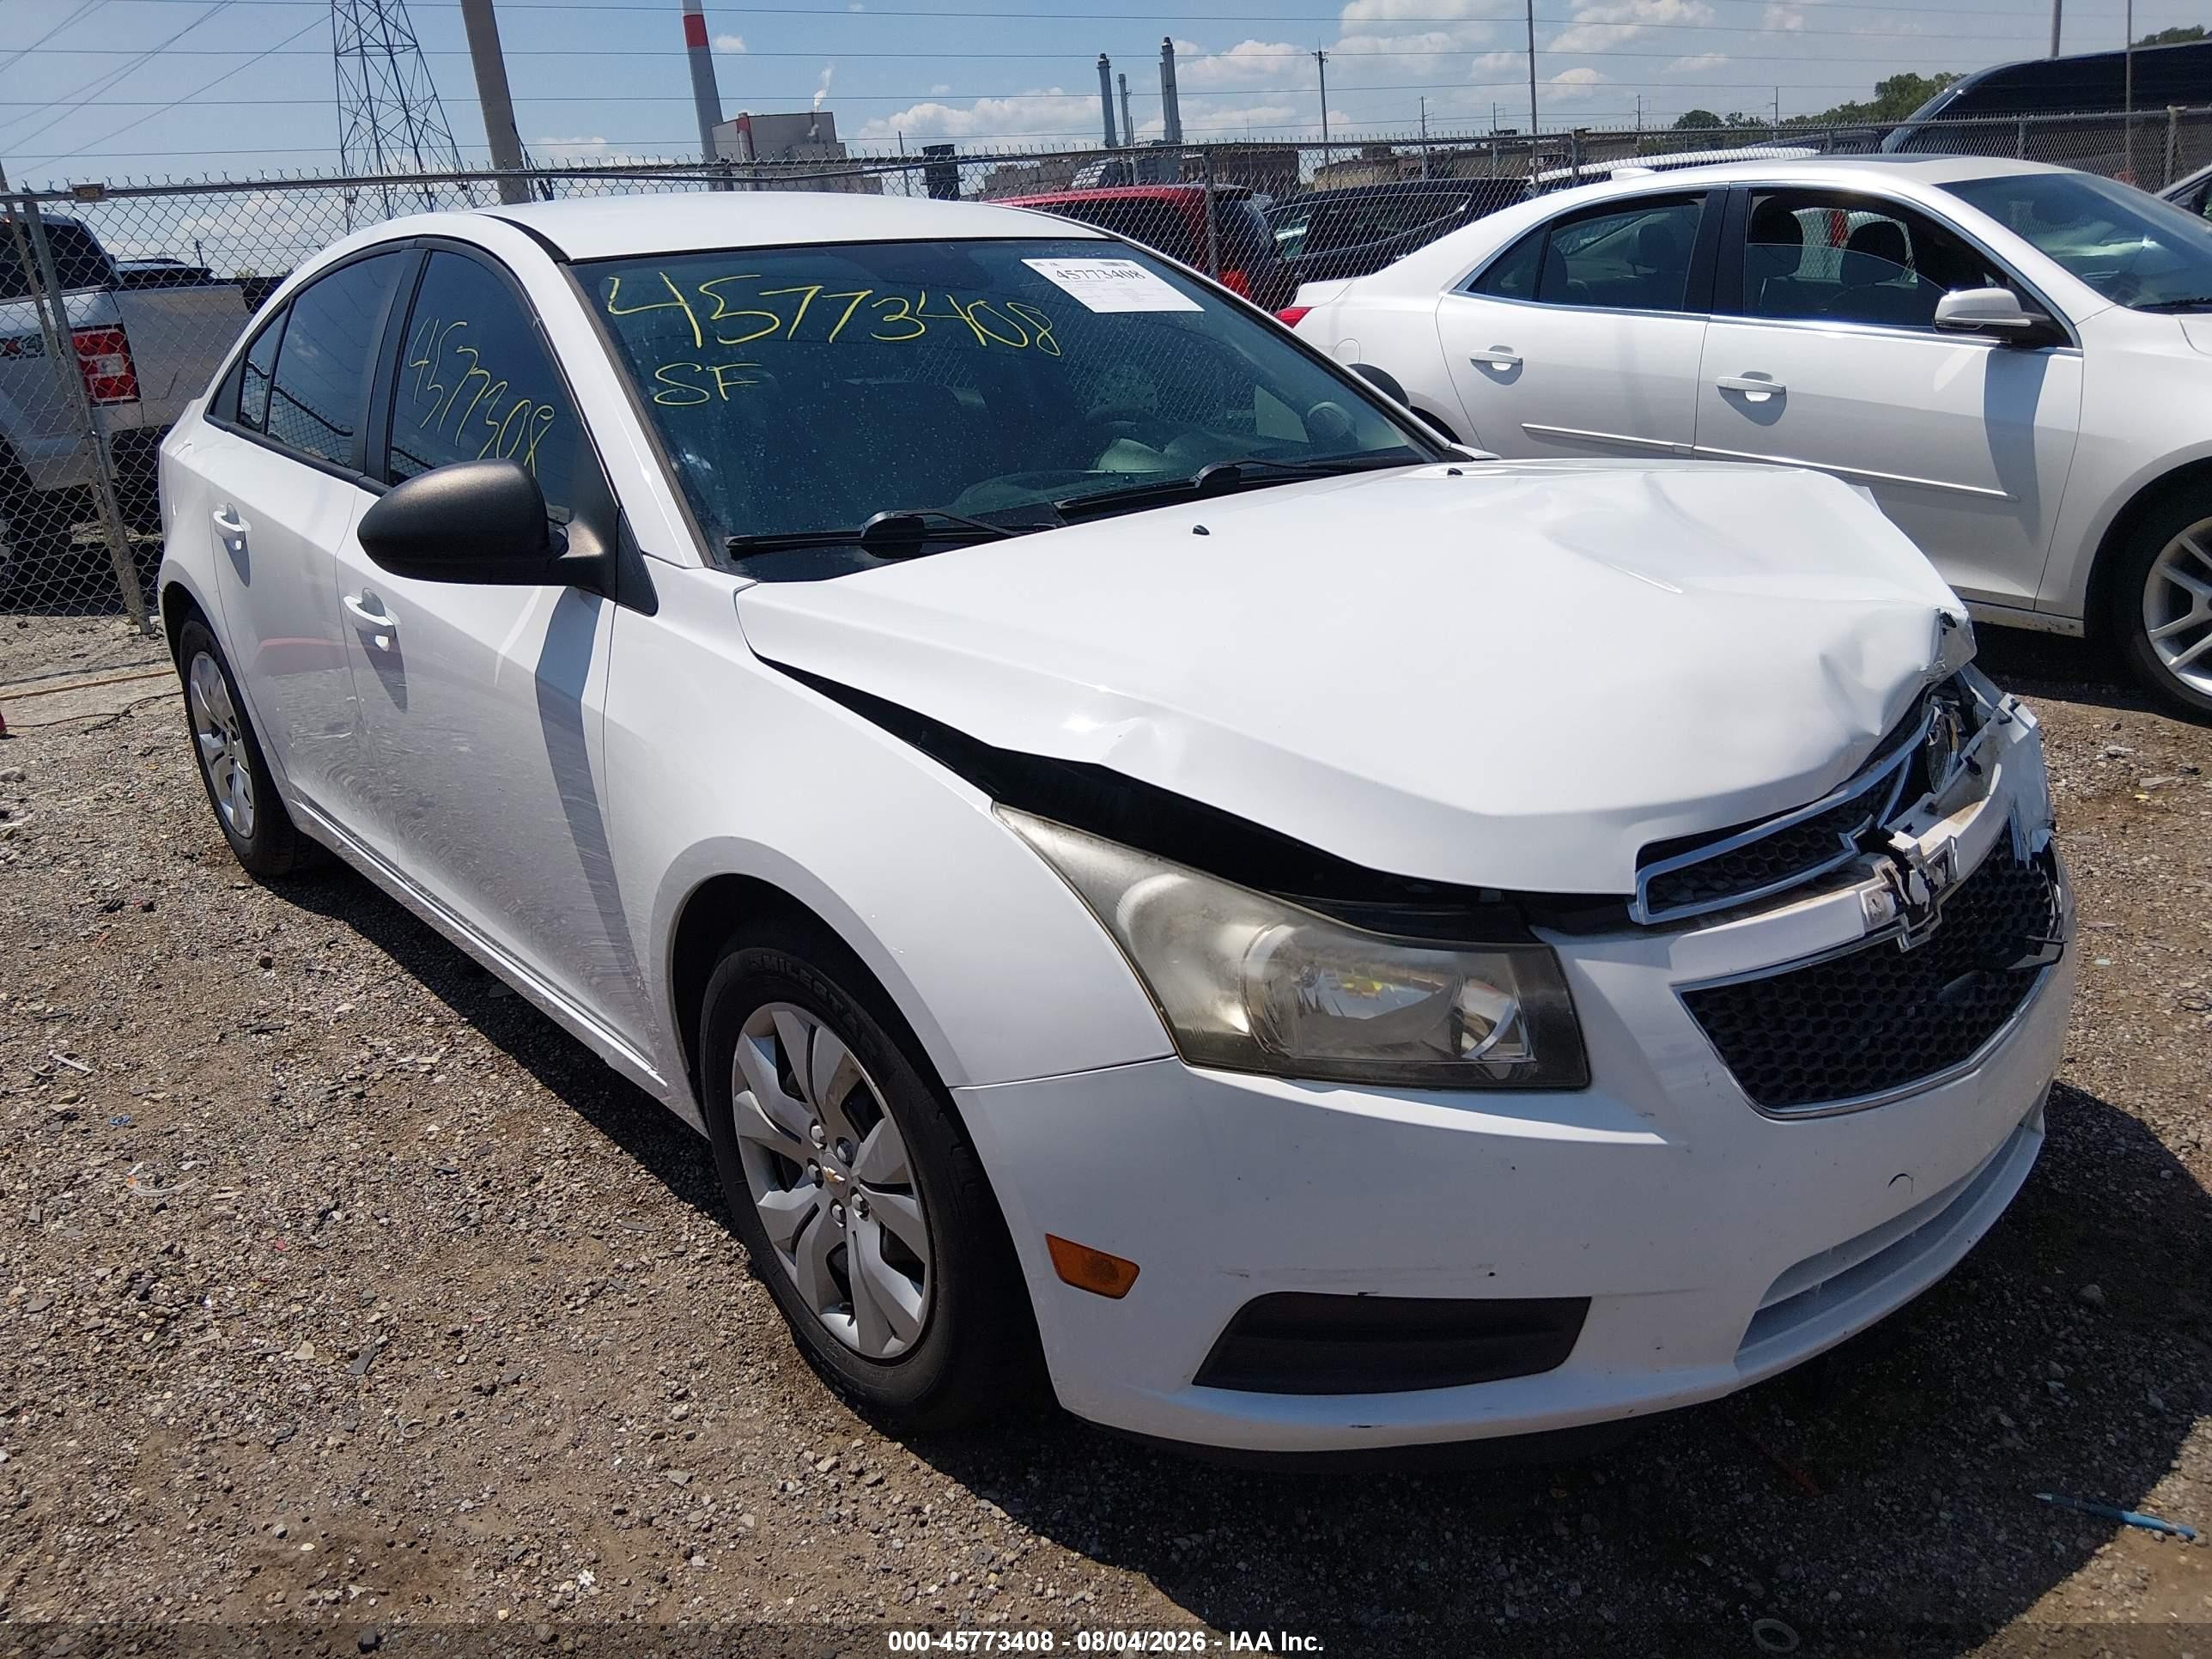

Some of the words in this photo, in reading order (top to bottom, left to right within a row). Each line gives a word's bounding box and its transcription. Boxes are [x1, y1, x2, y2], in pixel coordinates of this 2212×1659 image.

[1056, 269, 1146, 280] 45773408
[607, 271, 1061, 356] 45773408
[653, 362, 763, 406] SF
